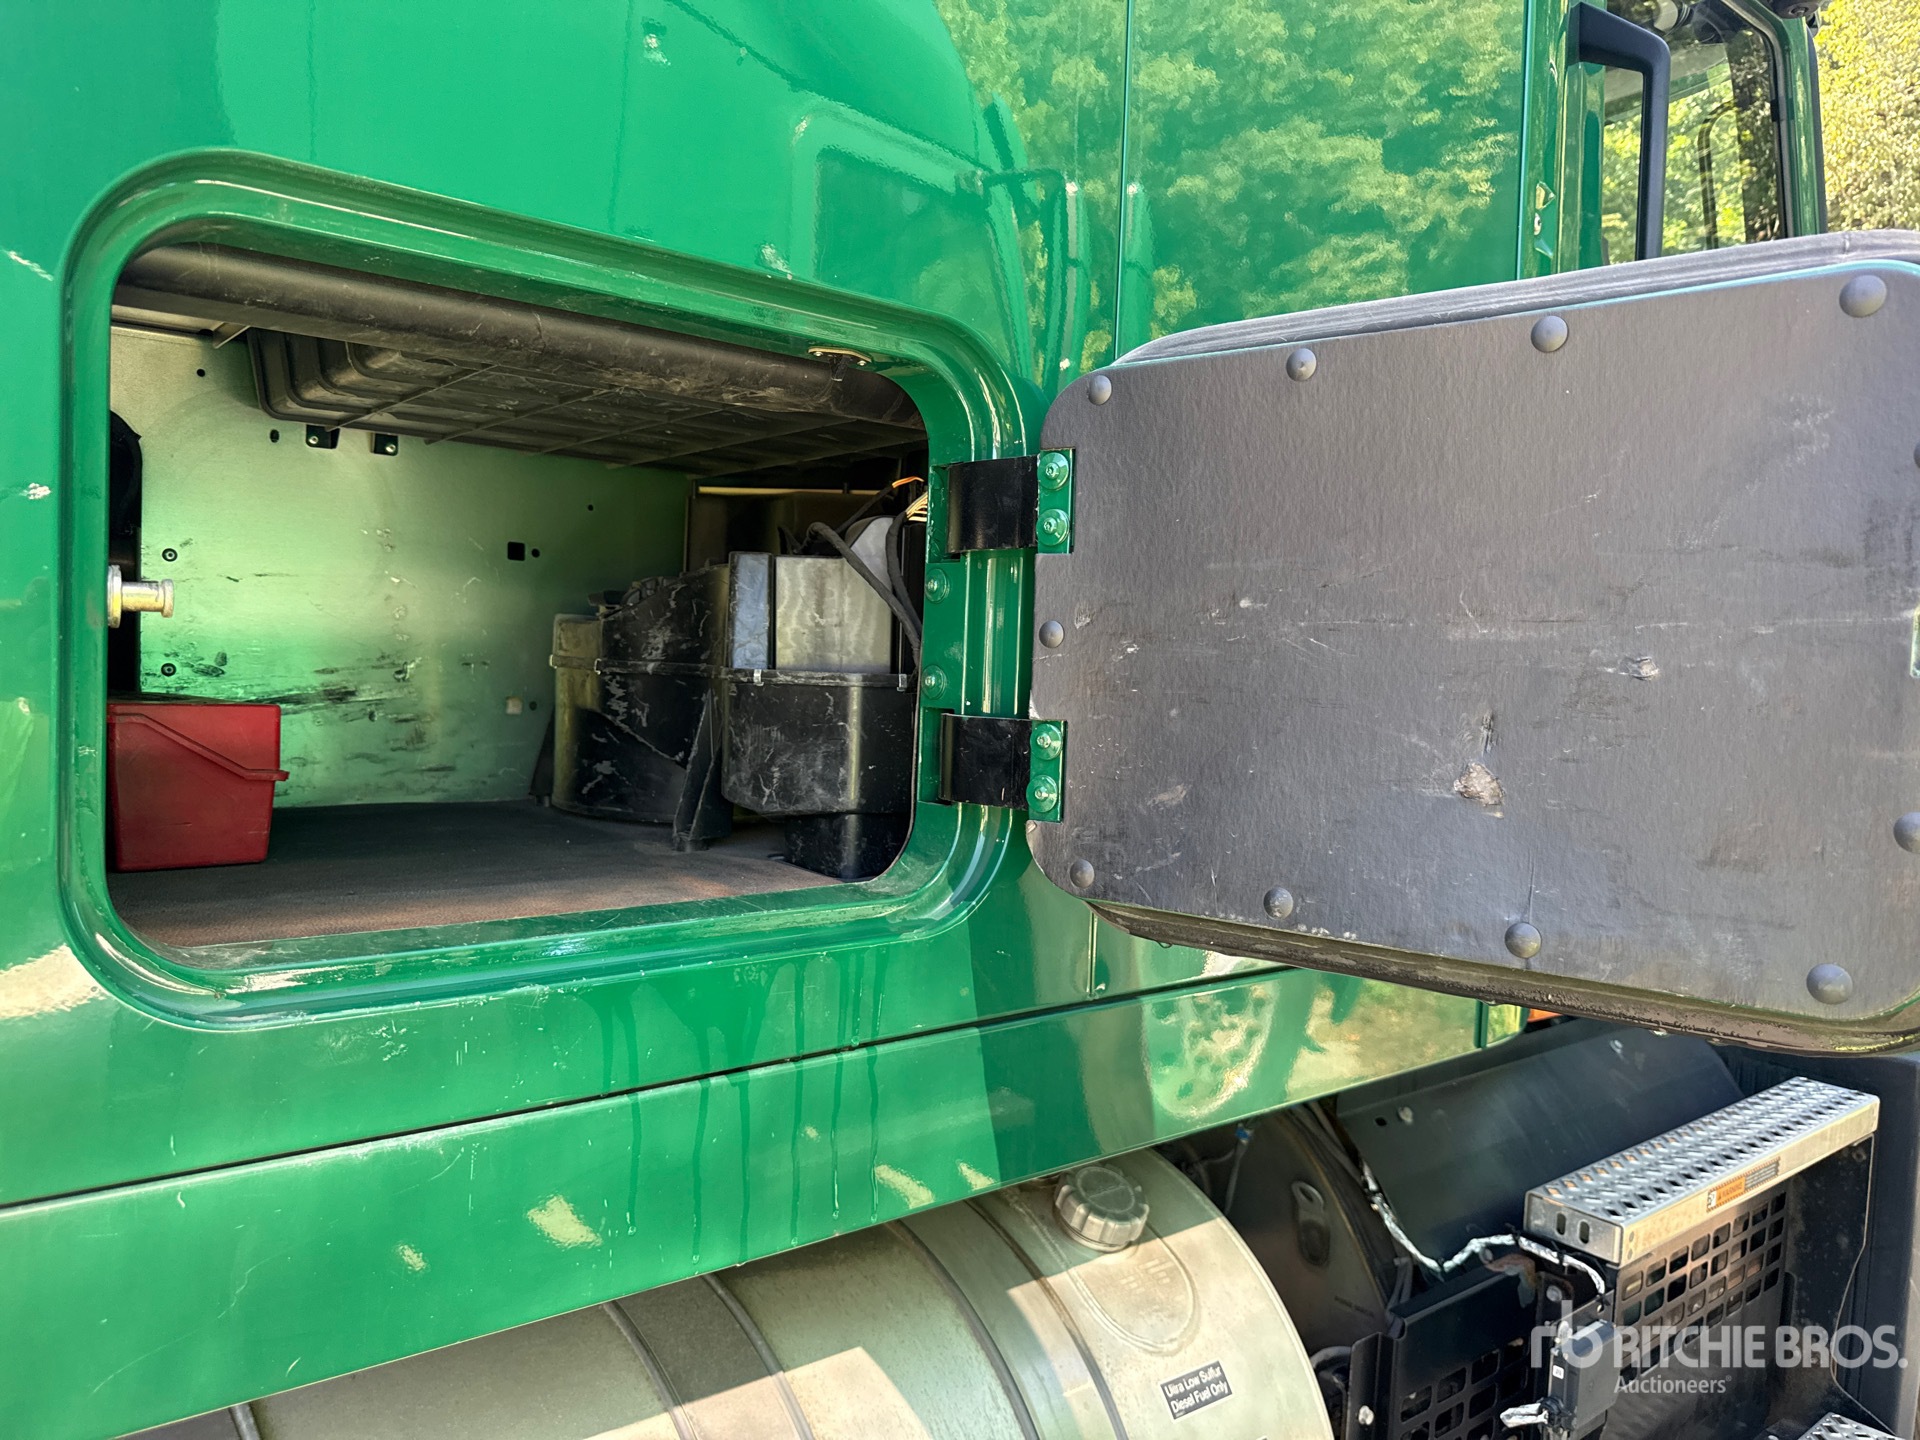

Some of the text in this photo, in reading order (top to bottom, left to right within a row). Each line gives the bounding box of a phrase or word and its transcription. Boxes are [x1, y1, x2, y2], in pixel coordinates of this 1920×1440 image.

[1183, 1376, 1200, 1390] Low
[1199, 1366, 1221, 1383] Sulfur
[1170, 1380, 1228, 1413] Diesel Fuel Only
